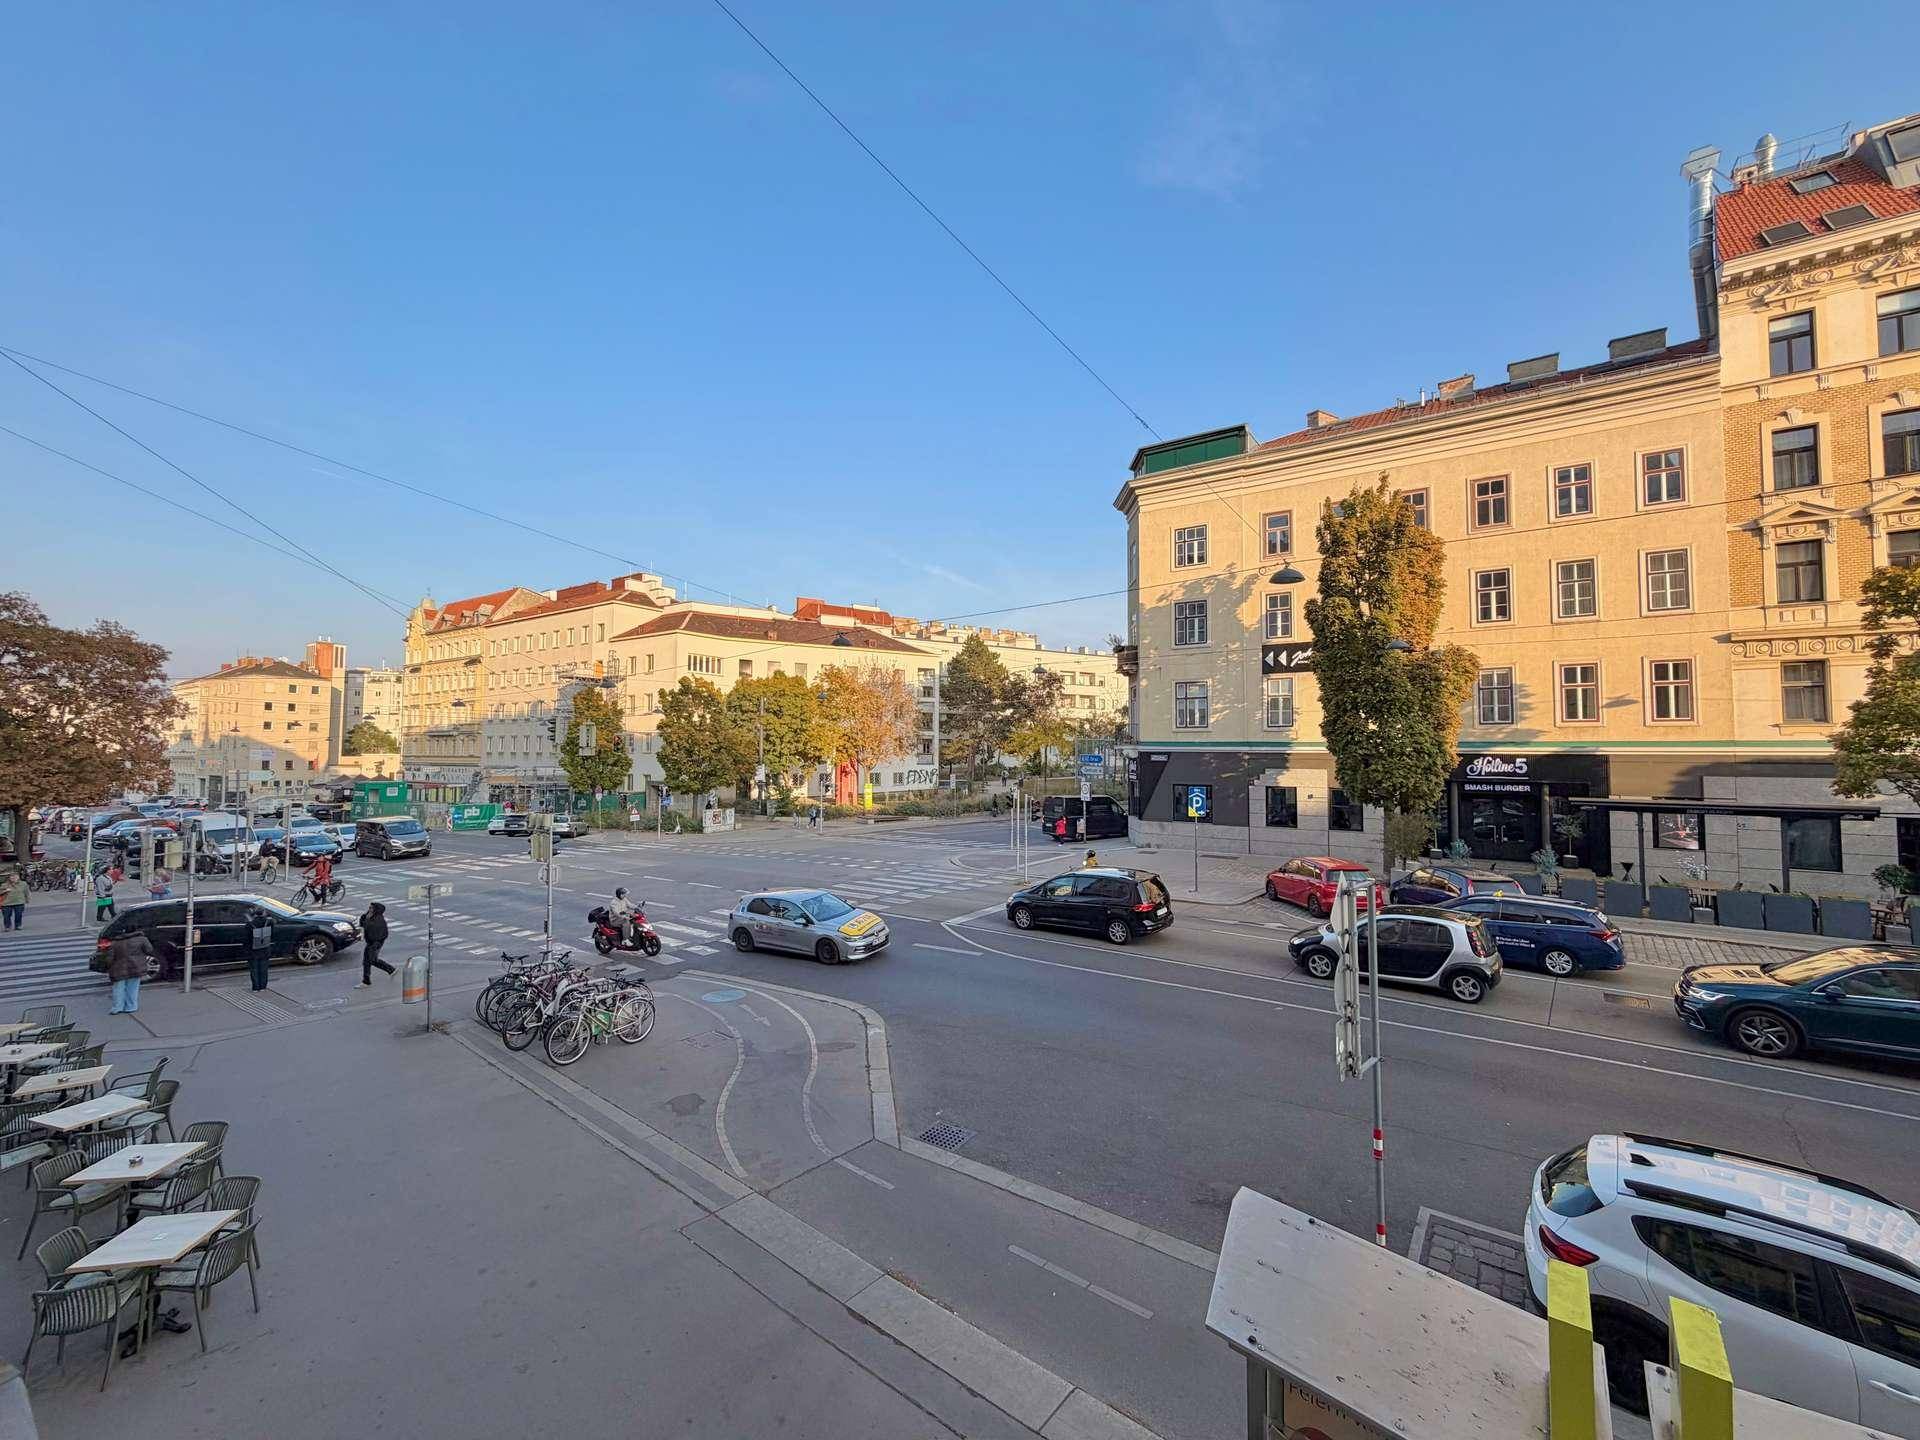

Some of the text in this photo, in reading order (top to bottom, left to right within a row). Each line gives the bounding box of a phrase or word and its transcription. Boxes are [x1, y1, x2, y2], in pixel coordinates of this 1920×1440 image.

[1464, 783, 1531, 792] SMASH BURGER
[464, 806, 481, 818] pb
